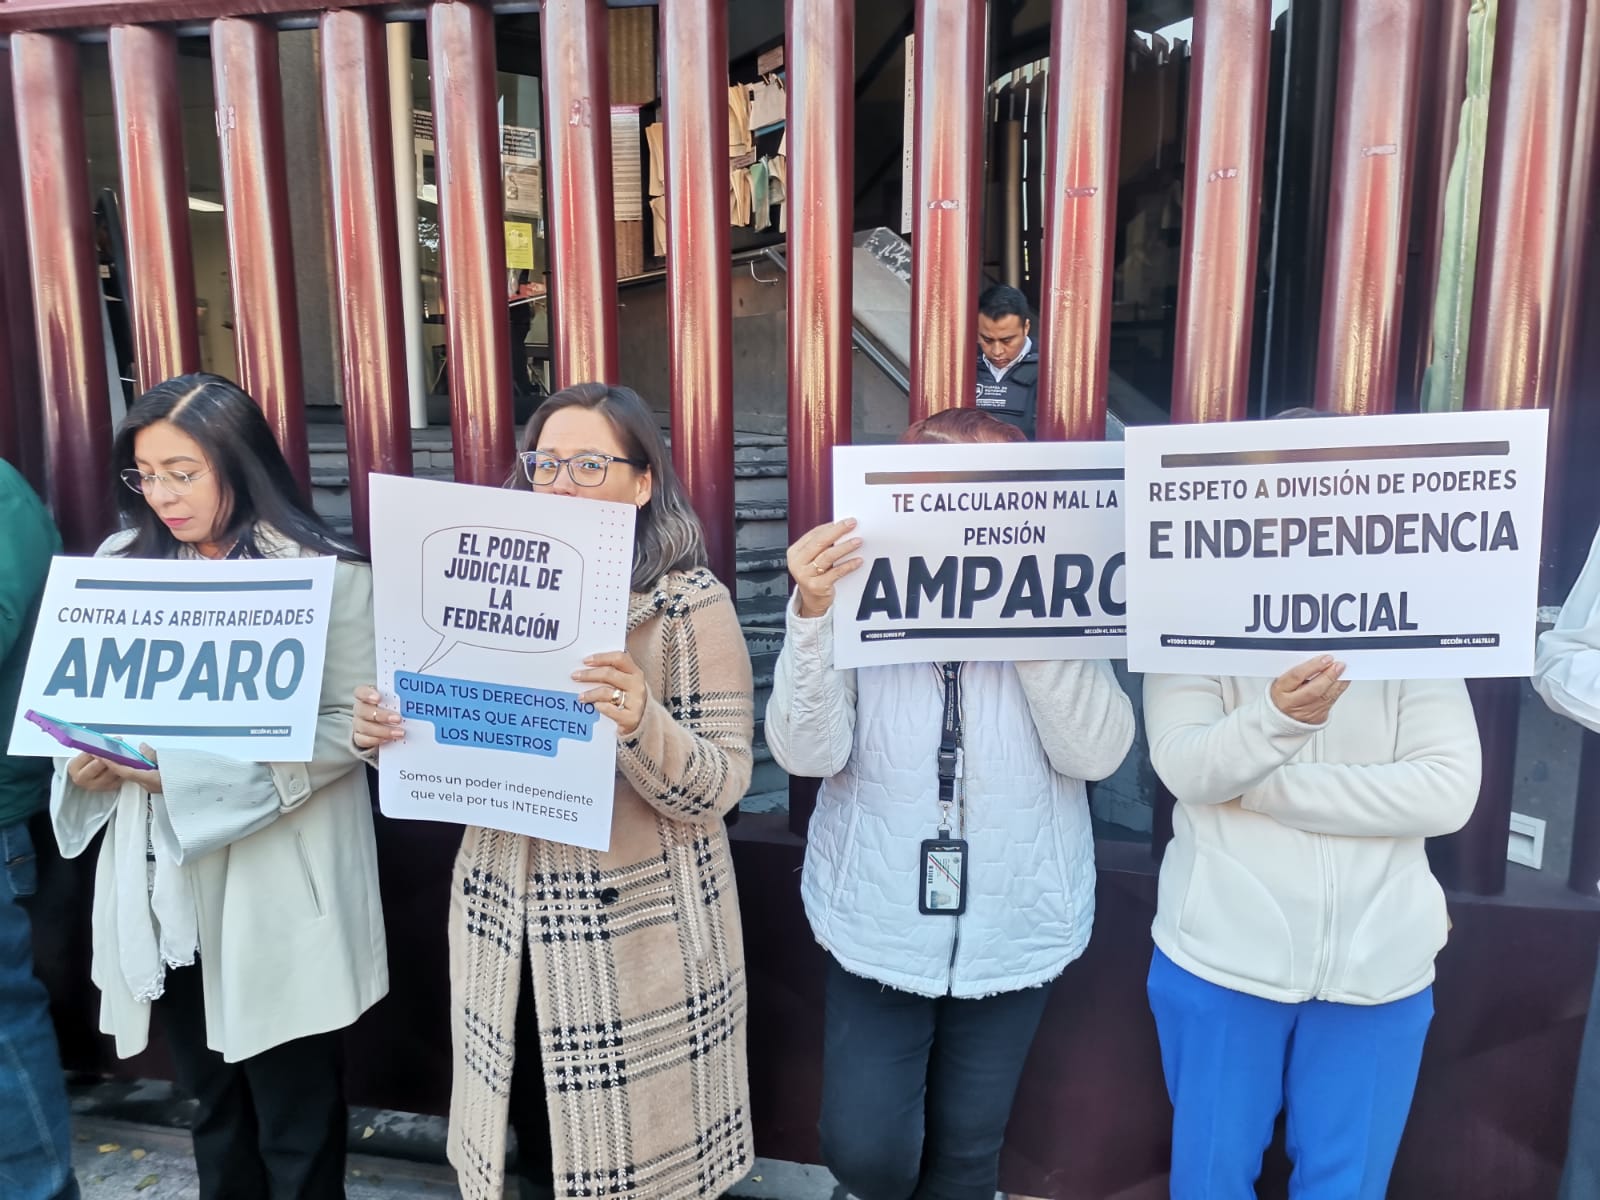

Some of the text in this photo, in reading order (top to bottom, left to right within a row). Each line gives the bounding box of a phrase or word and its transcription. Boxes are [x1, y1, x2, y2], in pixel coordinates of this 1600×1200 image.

[892, 490, 1119, 513] TE CALCULARON MAL LA
[1149, 469, 1517, 502] RESPETO A DIVISIÓN DE PODERES
[458, 533, 550, 564] EL PODER
[964, 521, 1046, 546] PENSIÓN
[1149, 510, 1519, 559] E INDEPENDENCIA
[444, 558, 563, 591] JUDICIAL DE
[856, 552, 1126, 621] AMPARO
[488, 588, 513, 611] LA
[1245, 591, 1418, 633] JUDICIAL
[58, 607, 314, 627] CONTRA LAS ARBITRARIEDADES
[443, 607, 560, 641] FEDERACIÓN
[1440, 637, 1463, 645] SECCIÓN
[43, 637, 305, 702] AMPARO
[400, 678, 595, 714] CUIDA TUS DERECHOS, NO
[406, 701, 587, 736] PERMITAS QUE AFECTEN
[441, 728, 552, 752] LOS NUESTROS
[400, 770, 593, 806] Somos un poder independiente
[411, 790, 579, 822] que vela por tus INTERESES
